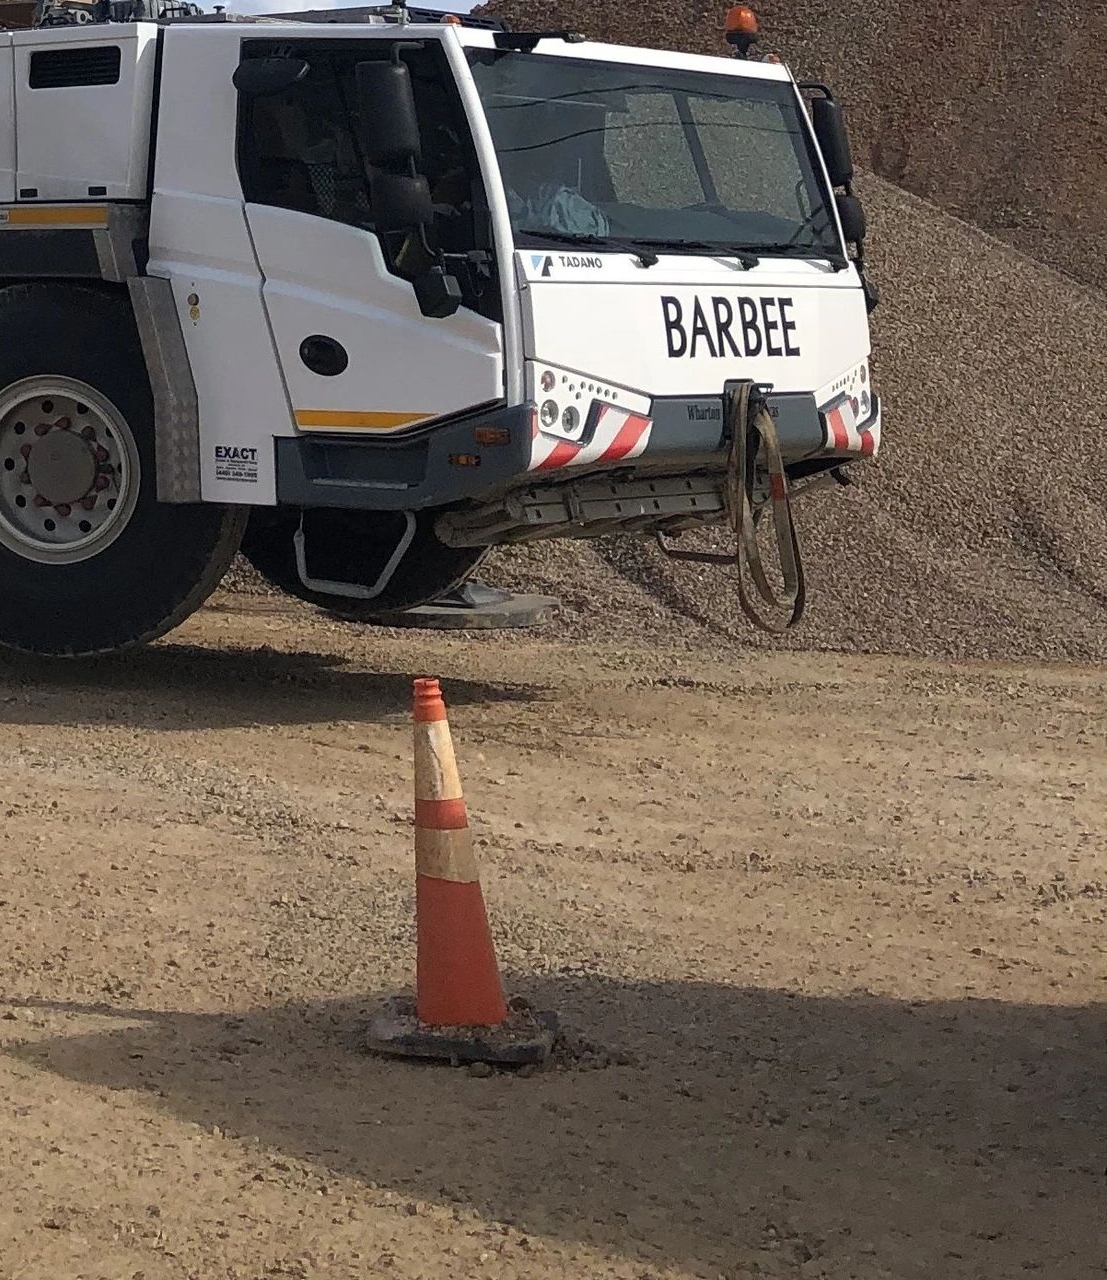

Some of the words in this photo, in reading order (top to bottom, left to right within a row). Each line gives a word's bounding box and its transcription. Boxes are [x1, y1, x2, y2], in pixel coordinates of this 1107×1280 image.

[559, 256, 603, 269] TADANO
[660, 295, 800, 358] BARBEE
[687, 404, 721, 420] Wharton
[215, 446, 258, 460] EXACT
